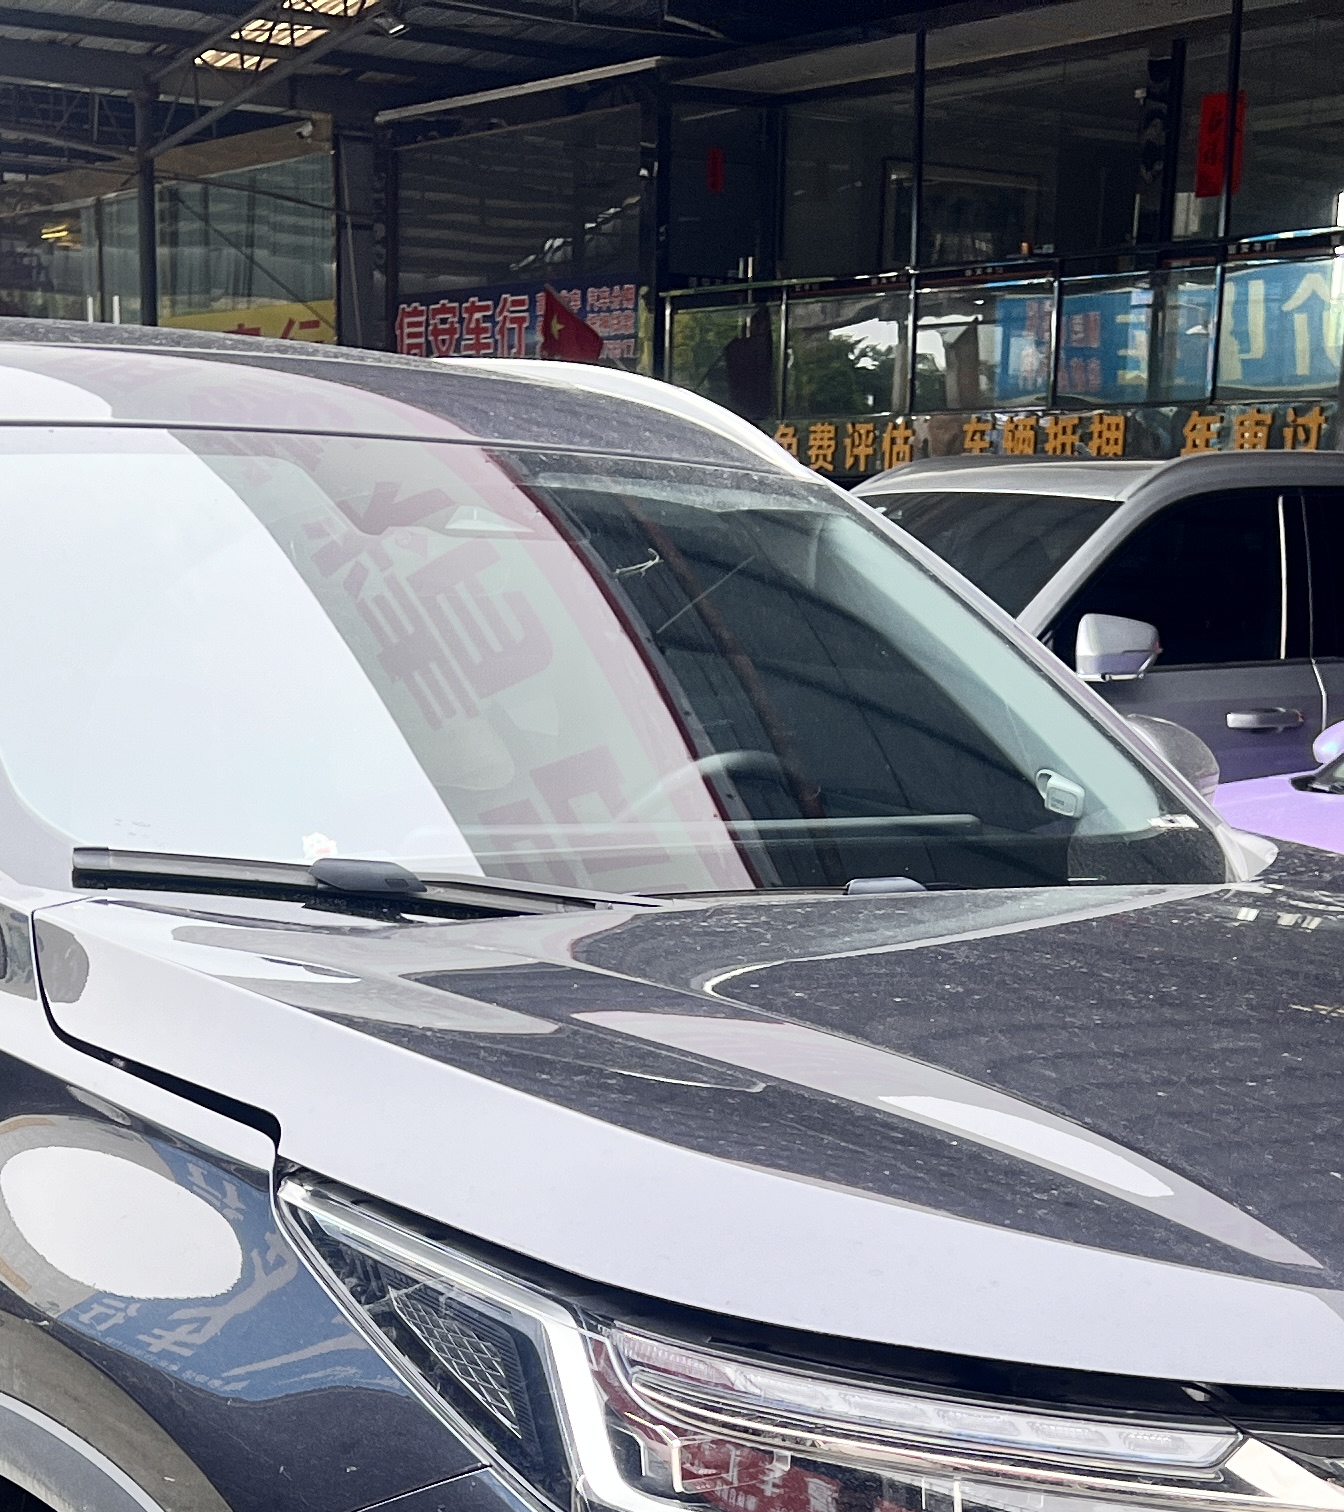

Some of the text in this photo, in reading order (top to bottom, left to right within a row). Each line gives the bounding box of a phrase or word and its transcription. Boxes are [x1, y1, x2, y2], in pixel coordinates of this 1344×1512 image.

[396, 294, 529, 358] 信安车行
[772, 421, 914, 472] 免费评估
[963, 413, 1126, 457] 车辆抵押
